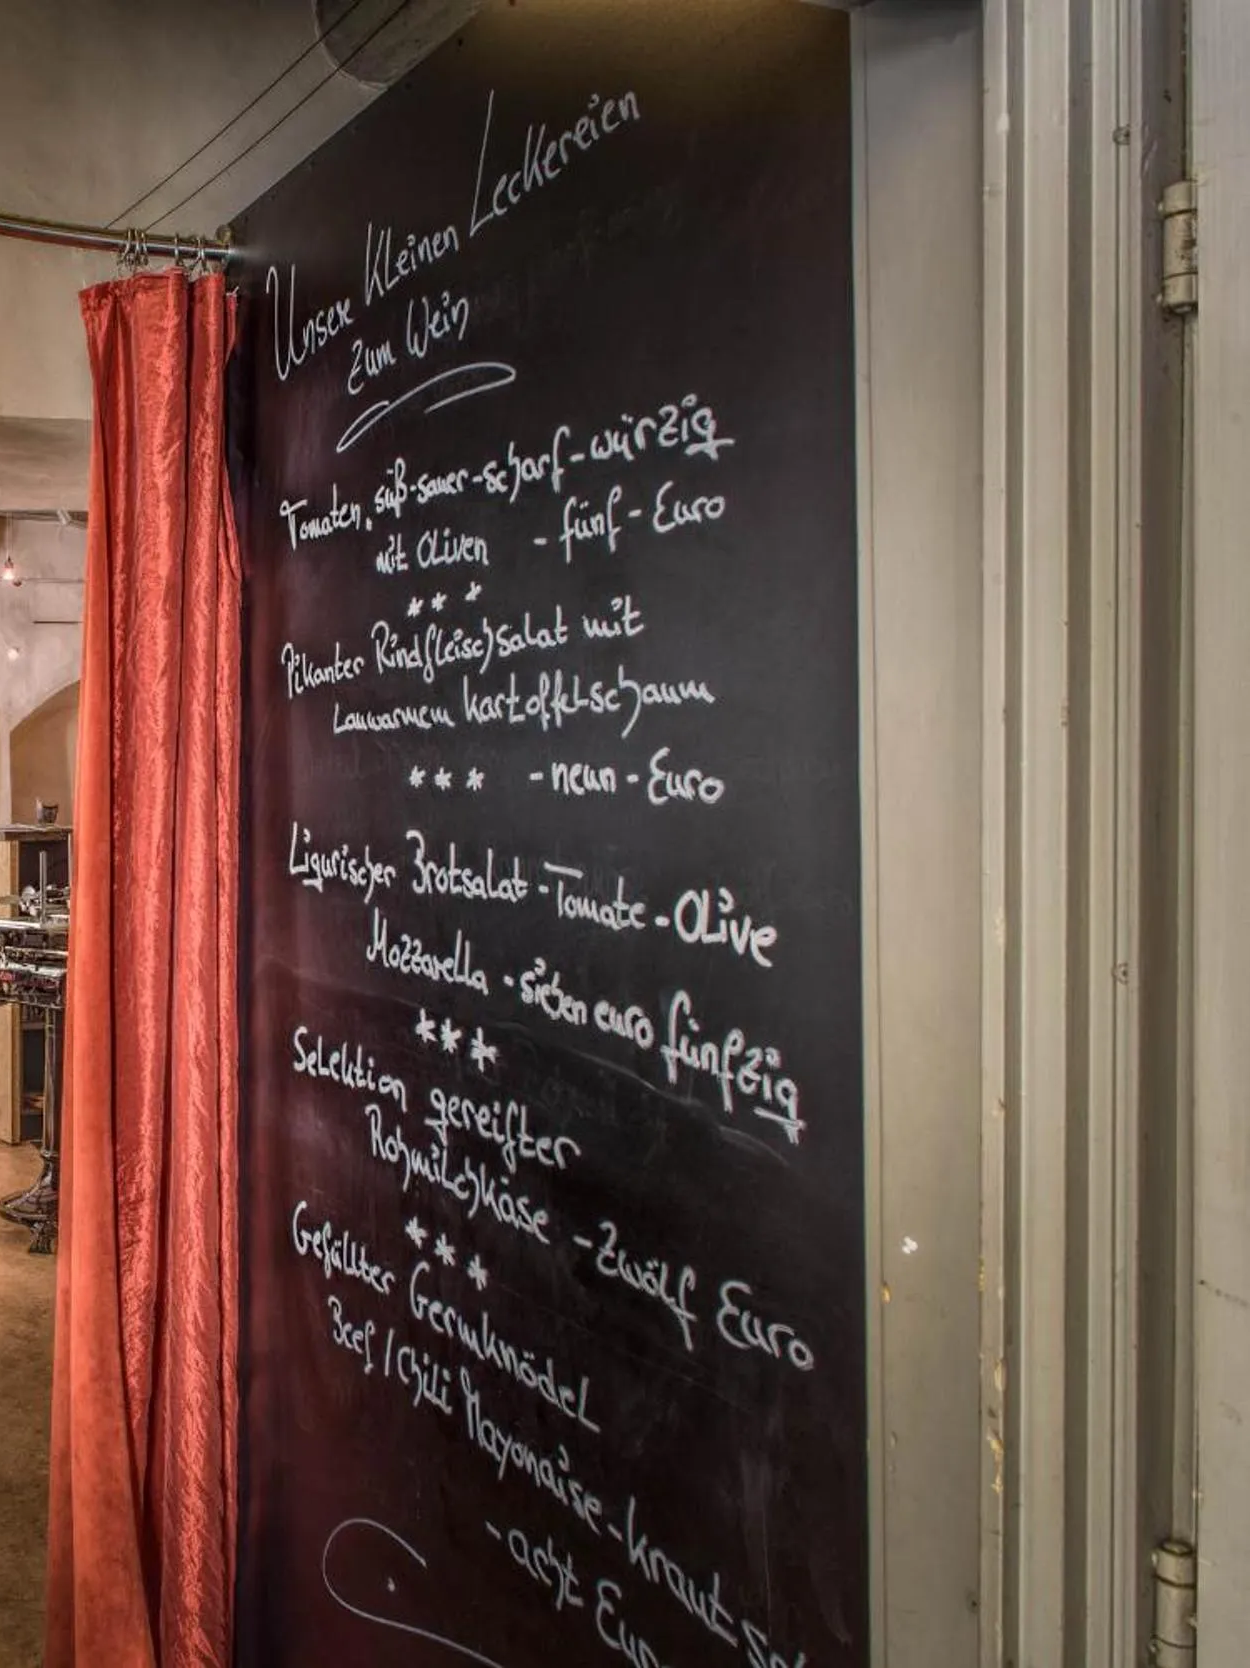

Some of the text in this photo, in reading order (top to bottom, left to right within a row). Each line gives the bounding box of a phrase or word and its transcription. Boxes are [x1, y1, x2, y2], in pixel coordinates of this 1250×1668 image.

[266, 263, 354, 381] Unsere
[470, 89, 641, 237] Leckereien
[406, 290, 470, 358] Wein
[376, 533, 409, 575] mit
[281, 642, 365, 698] Pikanter
[582, 595, 645, 638] mit
[289, 822, 397, 904] Ligurischer
[661, 990, 806, 1144] fünfzig
[424, 1086, 582, 1175] gereifter
[293, 1200, 397, 1296] Gefüllter
[365, 1103, 550, 1244] Rohmilchkäse
[717, 1280, 814, 1371] Euro
[327, 1294, 377, 1376] Beef
[397, 1345, 453, 1416] Chili
[508, 1529, 585, 1611] acht
